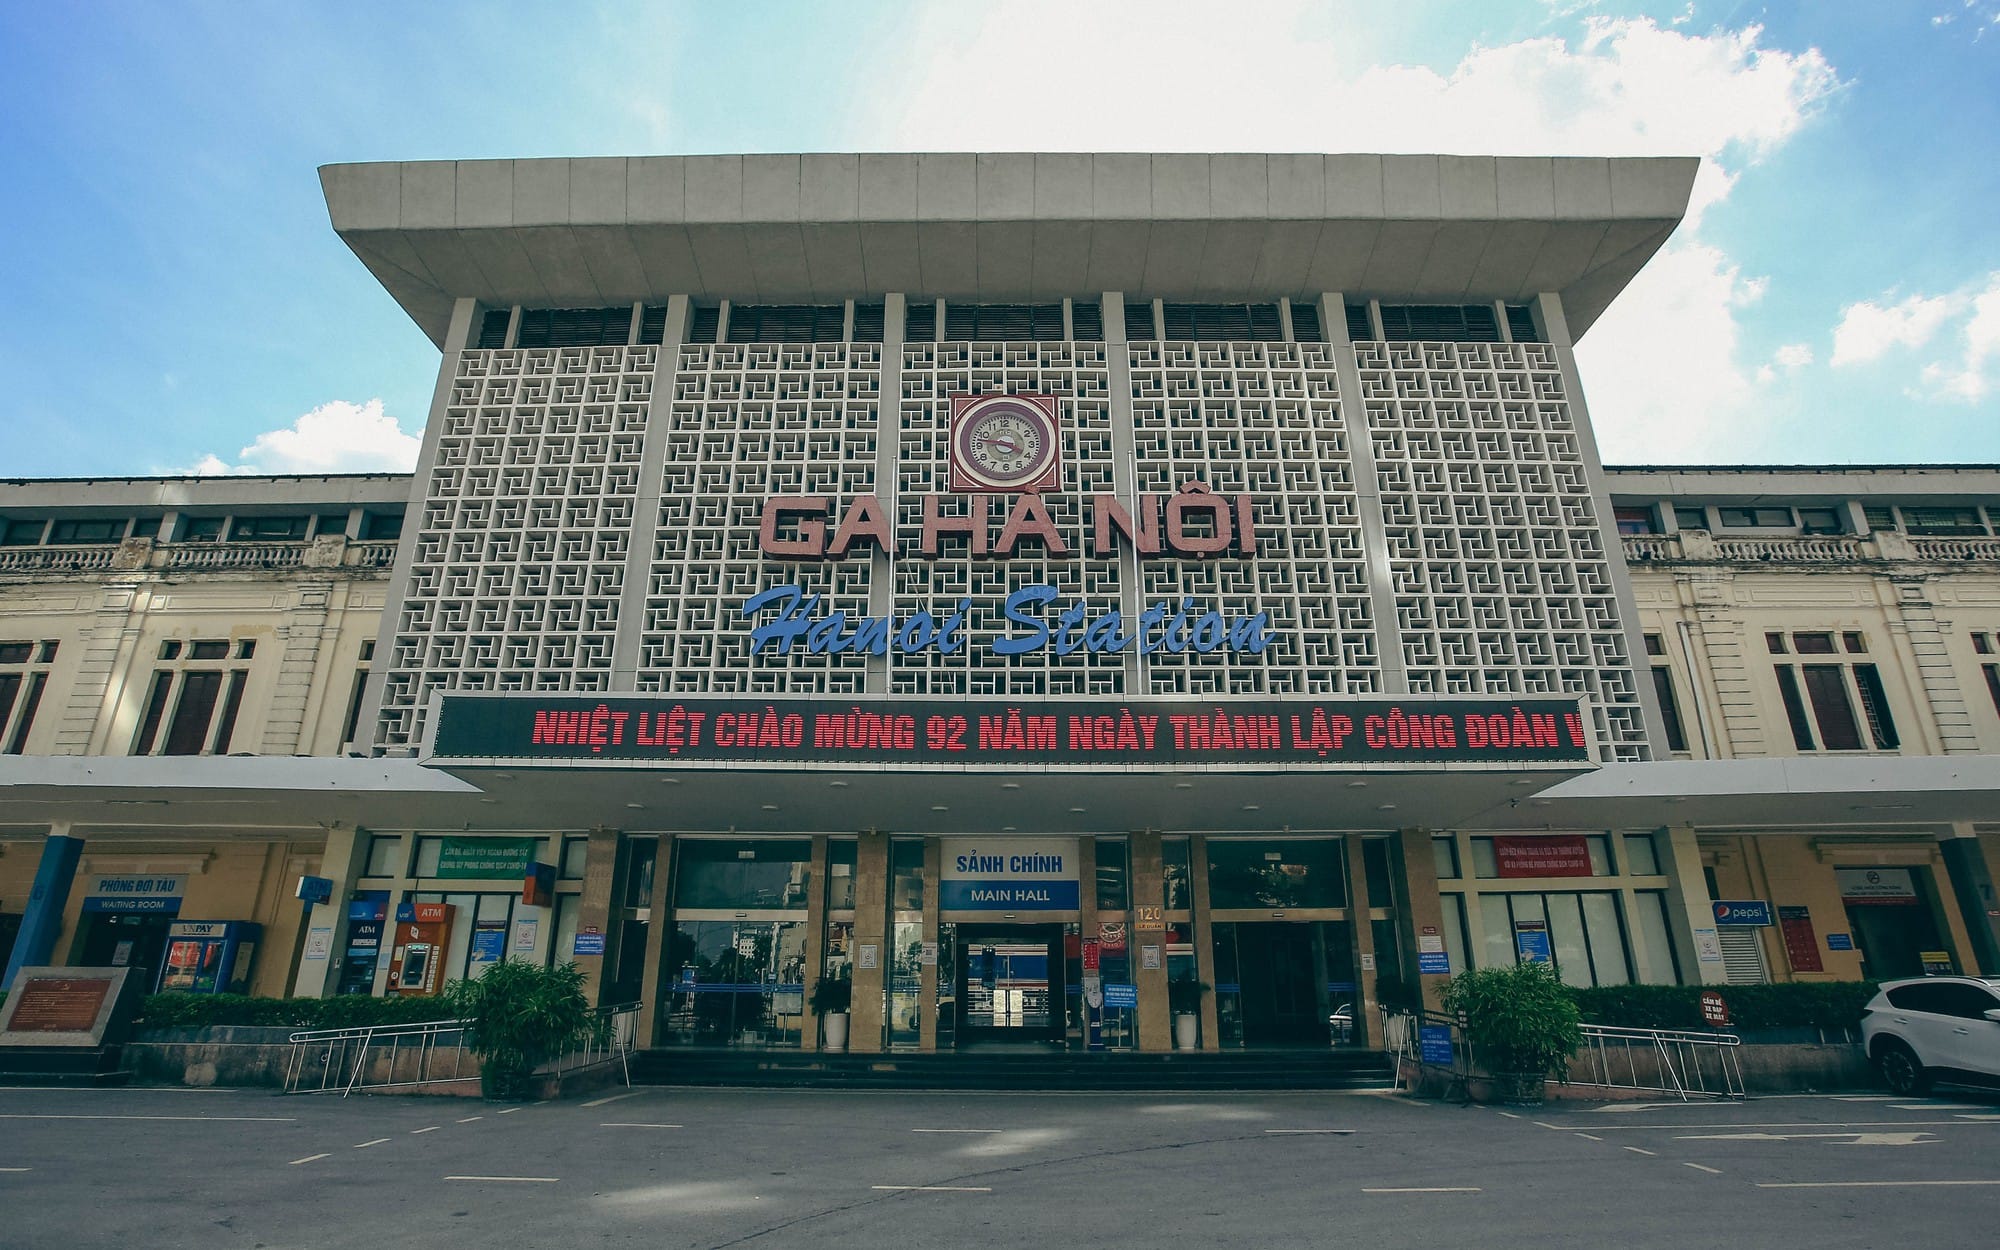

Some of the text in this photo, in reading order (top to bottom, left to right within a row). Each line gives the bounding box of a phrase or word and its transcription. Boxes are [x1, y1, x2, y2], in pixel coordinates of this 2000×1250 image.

[1000, 419, 1010, 427] 12
[1024, 429, 1031, 438] 2
[990, 461, 997, 469] 7
[1003, 463, 1010, 471] 6
[759, 479, 1256, 561] GA HÀ NỘI
[743, 584, 1276, 656] Hanoi Station
[532, 704, 629, 753] NHIỆT
[637, 704, 705, 754] LIỆT
[714, 706, 803, 749] CHÀO
[814, 707, 914, 750] MỪNG
[926, 715, 967, 752] 92
[978, 708, 1056, 751] NĂM
[1069, 708, 1159, 751] NGÀY
[1169, 707, 1281, 751] THÀNH
[1291, 707, 1354, 757] LẬP
[1364, 707, 1457, 750] CÔNG
[1466, 706, 1560, 748] ĐOÀN
[956, 849, 1063, 873] SẢNH CHÍNH
[99, 877, 176, 895] PHÒNG ĐỢI TÀU
[971, 890, 1050, 901] MAIN HALL
[101, 901, 165, 909] WAITING ROOM
[421, 908, 442, 917] ATM
[1137, 907, 1160, 920] 120
[1733, 907, 1762, 918] pepsi
[182, 925, 214, 933] VNPAY
[358, 926, 375, 934] ATM
